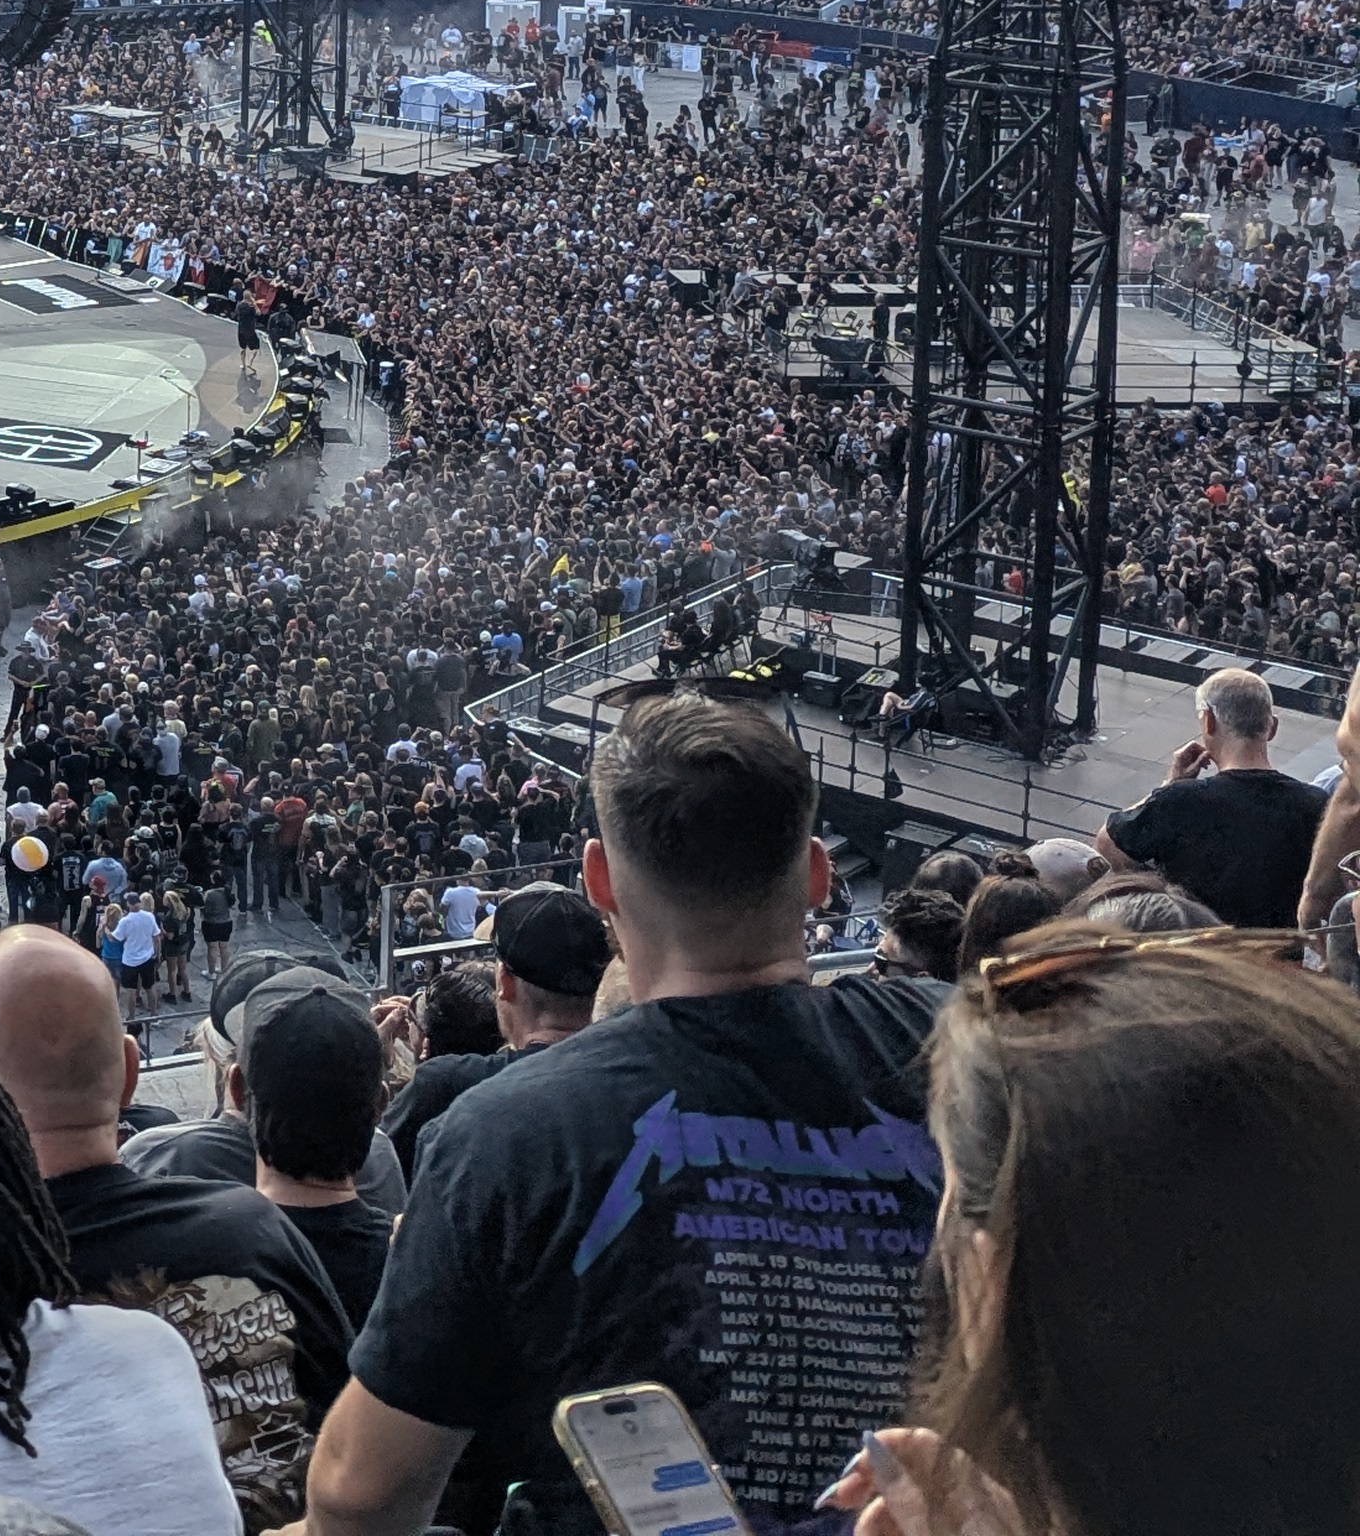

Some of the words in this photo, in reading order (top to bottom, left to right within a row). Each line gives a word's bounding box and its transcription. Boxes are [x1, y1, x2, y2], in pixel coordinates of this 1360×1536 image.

[705, 1178, 773, 1206] M72
[781, 1186, 900, 1215] NORTH
[673, 1213, 847, 1251] AMERICAN
[857, 1227, 927, 1255] TOU
[714, 1252, 765, 1267] APRIL
[704, 1270, 756, 1286] APRIL
[760, 1274, 815, 1291] 24/26
[720, 1291, 757, 1306] MAY
[720, 1312, 759, 1326] MAY
[721, 1331, 761, 1346] MAY
[699, 1349, 740, 1364] MAY
[731, 1371, 772, 1386] MAY
[729, 1390, 771, 1404] MAY
[745, 1410, 789, 1426] JUNE
[749, 1430, 793, 1446] JUNE
